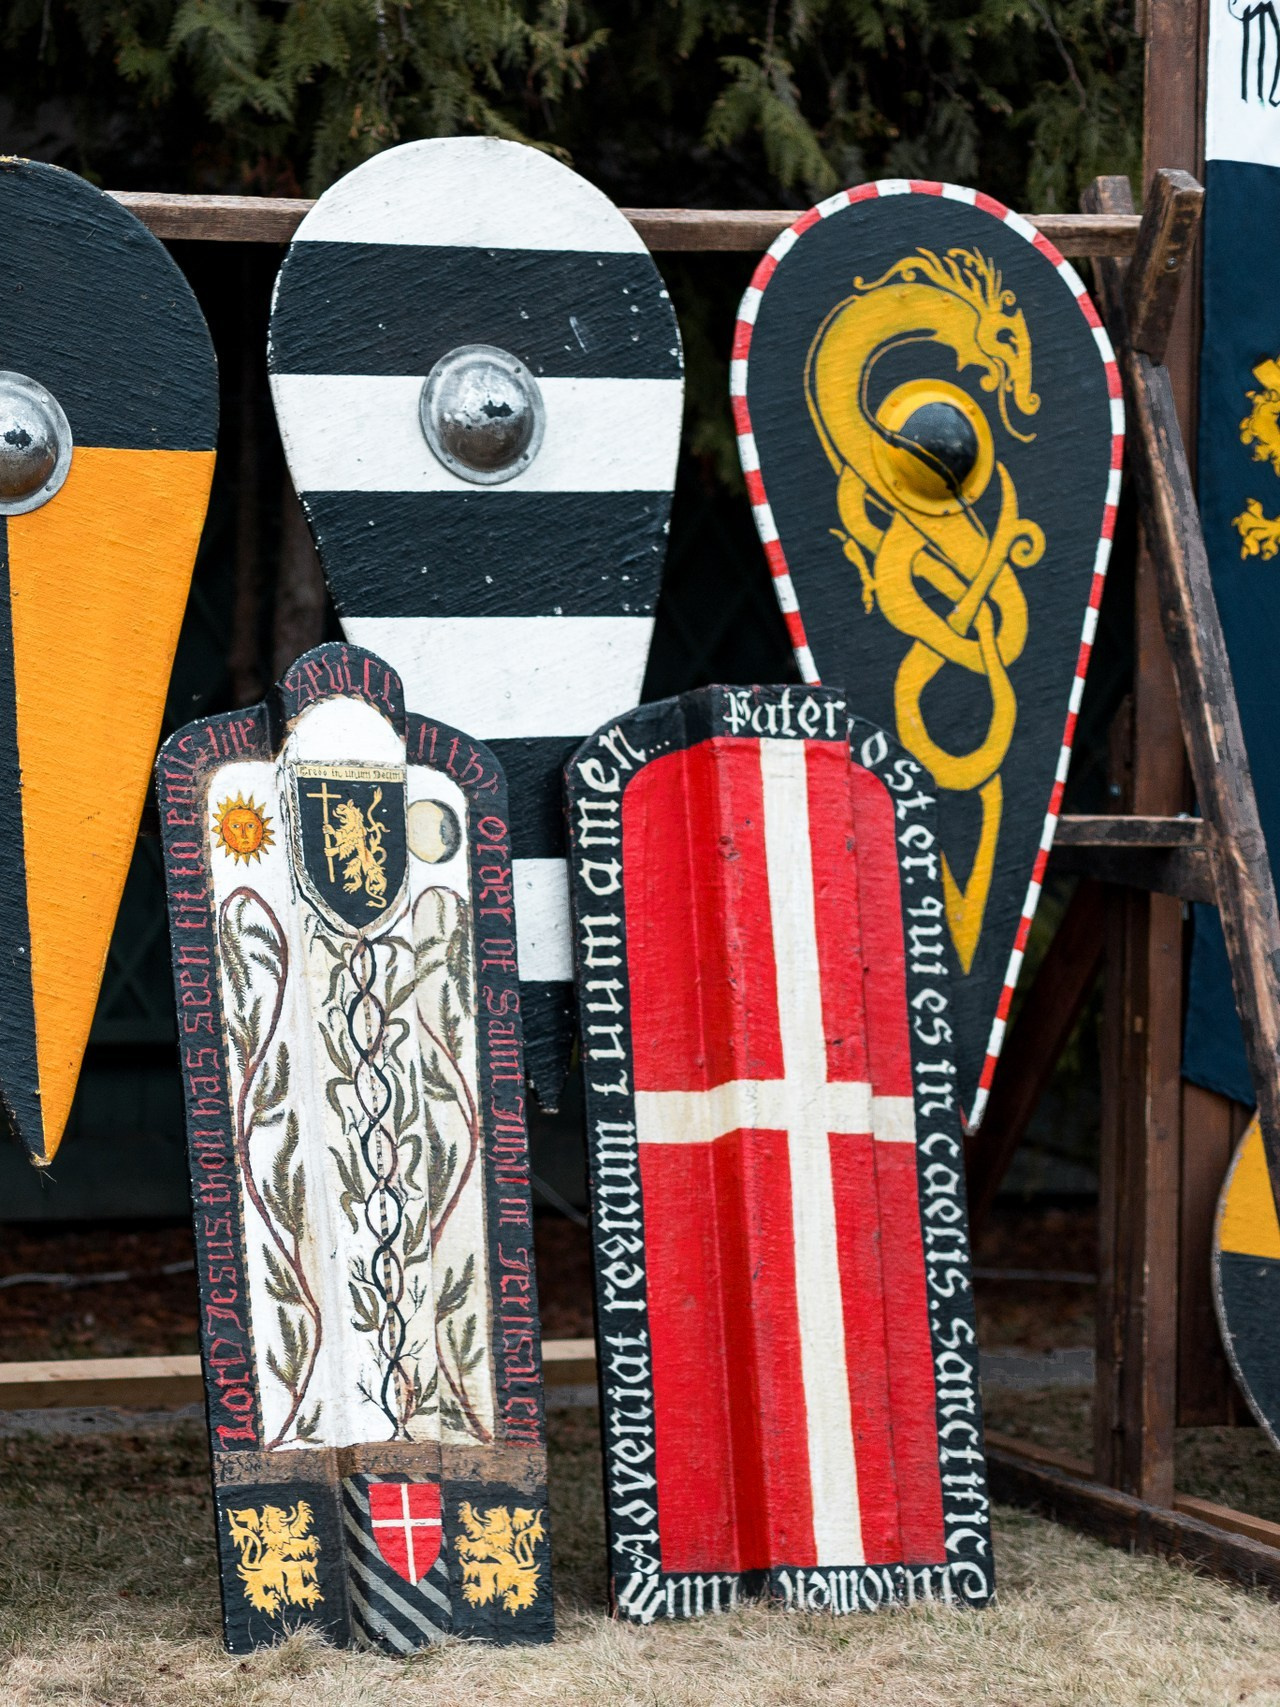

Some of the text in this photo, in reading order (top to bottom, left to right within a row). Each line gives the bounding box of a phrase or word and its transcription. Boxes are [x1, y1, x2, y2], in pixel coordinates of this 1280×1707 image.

[170, 841, 204, 877] to
[174, 888, 207, 929] fit
[909, 896, 948, 975] qui
[481, 938, 516, 972] of
[484, 985, 523, 1088] Saint
[912, 989, 951, 1046] es
[188, 1046, 220, 1116] has
[915, 1060, 956, 1117] in
[198, 1129, 231, 1206] thou
[497, 1197, 530, 1229] of
[596, 1115, 646, 1311] regnum
